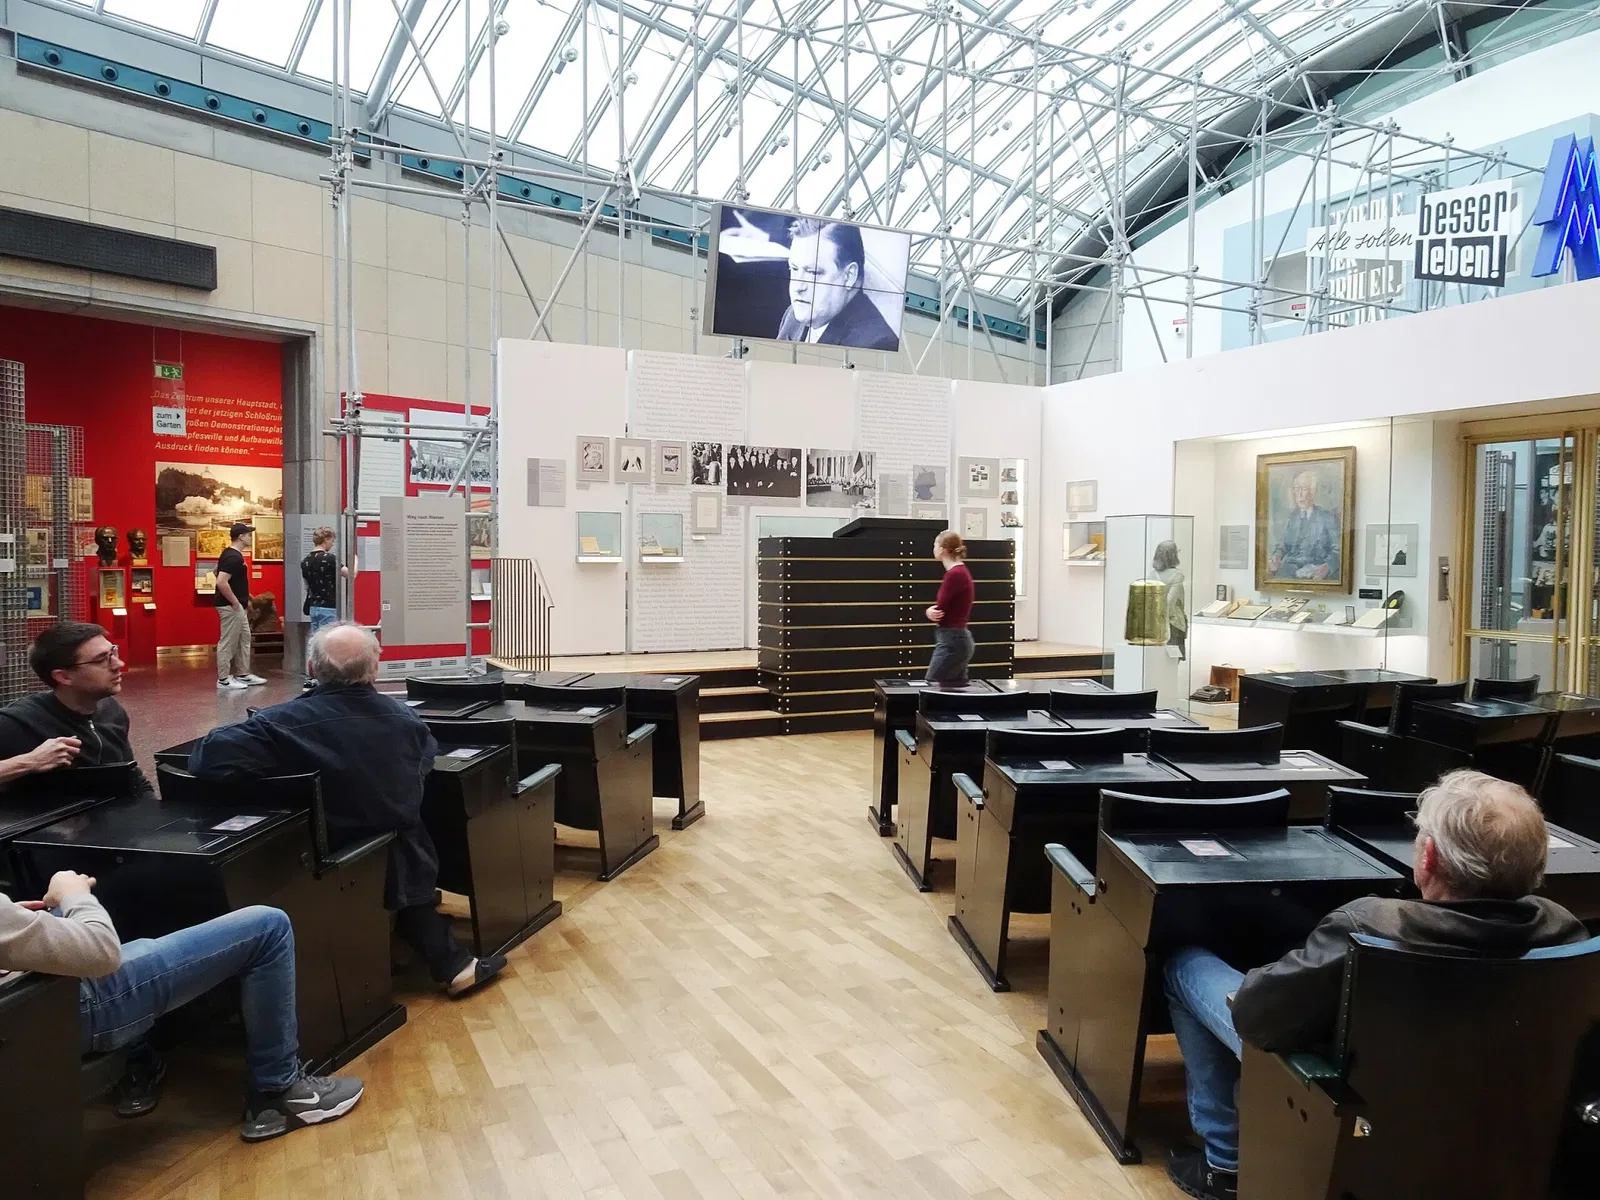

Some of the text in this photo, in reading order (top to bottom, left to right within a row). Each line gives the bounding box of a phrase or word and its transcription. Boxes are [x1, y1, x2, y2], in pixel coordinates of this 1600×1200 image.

[1419, 191, 1507, 236] besser
[1310, 227, 1413, 252] Alle sollen
[1421, 236, 1500, 279] leben!
[171, 391, 203, 402] Zentrum
[205, 396, 235, 405] unserer
[236, 398, 278, 409] Hauptstadt,
[199, 408, 212, 416] der
[213, 409, 243, 418] jetzigen
[156, 420, 182, 429] Garten
[186, 419, 209, 428] roßen
[155, 441, 193, 451] Ausdruck
[195, 443, 219, 453] finden
